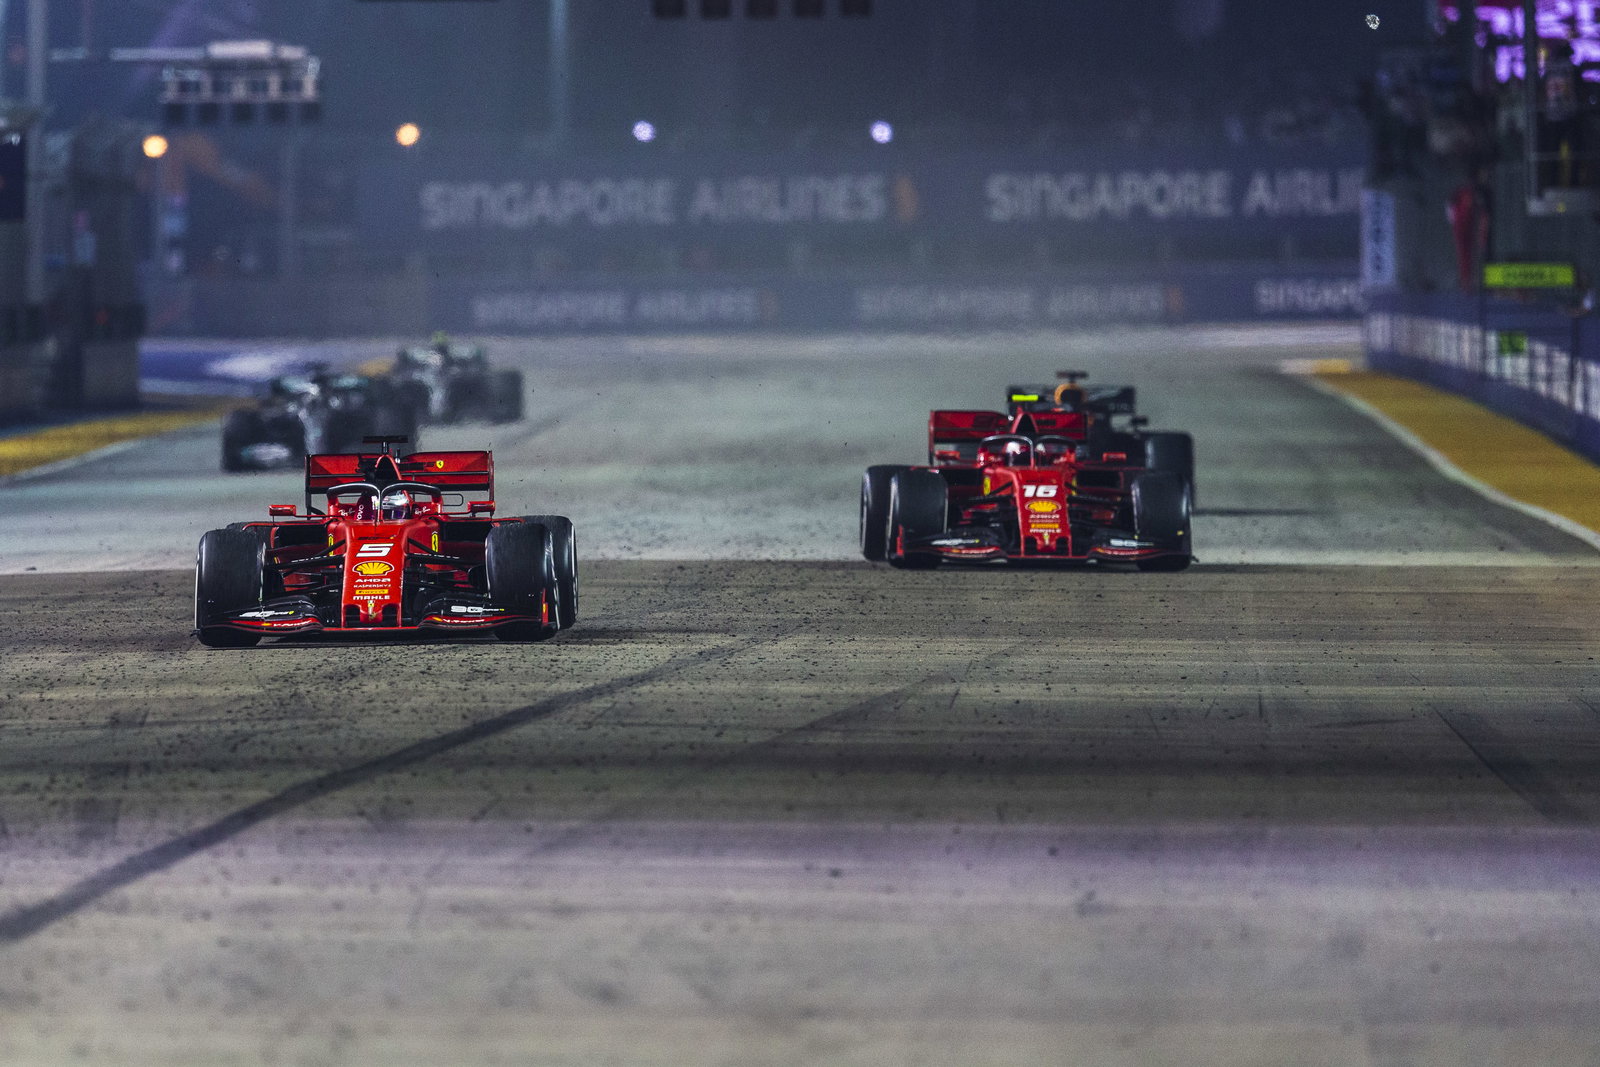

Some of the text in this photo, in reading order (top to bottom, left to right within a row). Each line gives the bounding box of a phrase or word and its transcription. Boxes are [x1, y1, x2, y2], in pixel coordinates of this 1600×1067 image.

[420, 174, 886, 230] SINGAPORE AIRLINES
[984, 171, 1232, 221] SINGAPORE
[1022, 485, 1059, 498] 16
[355, 543, 394, 557] 5
